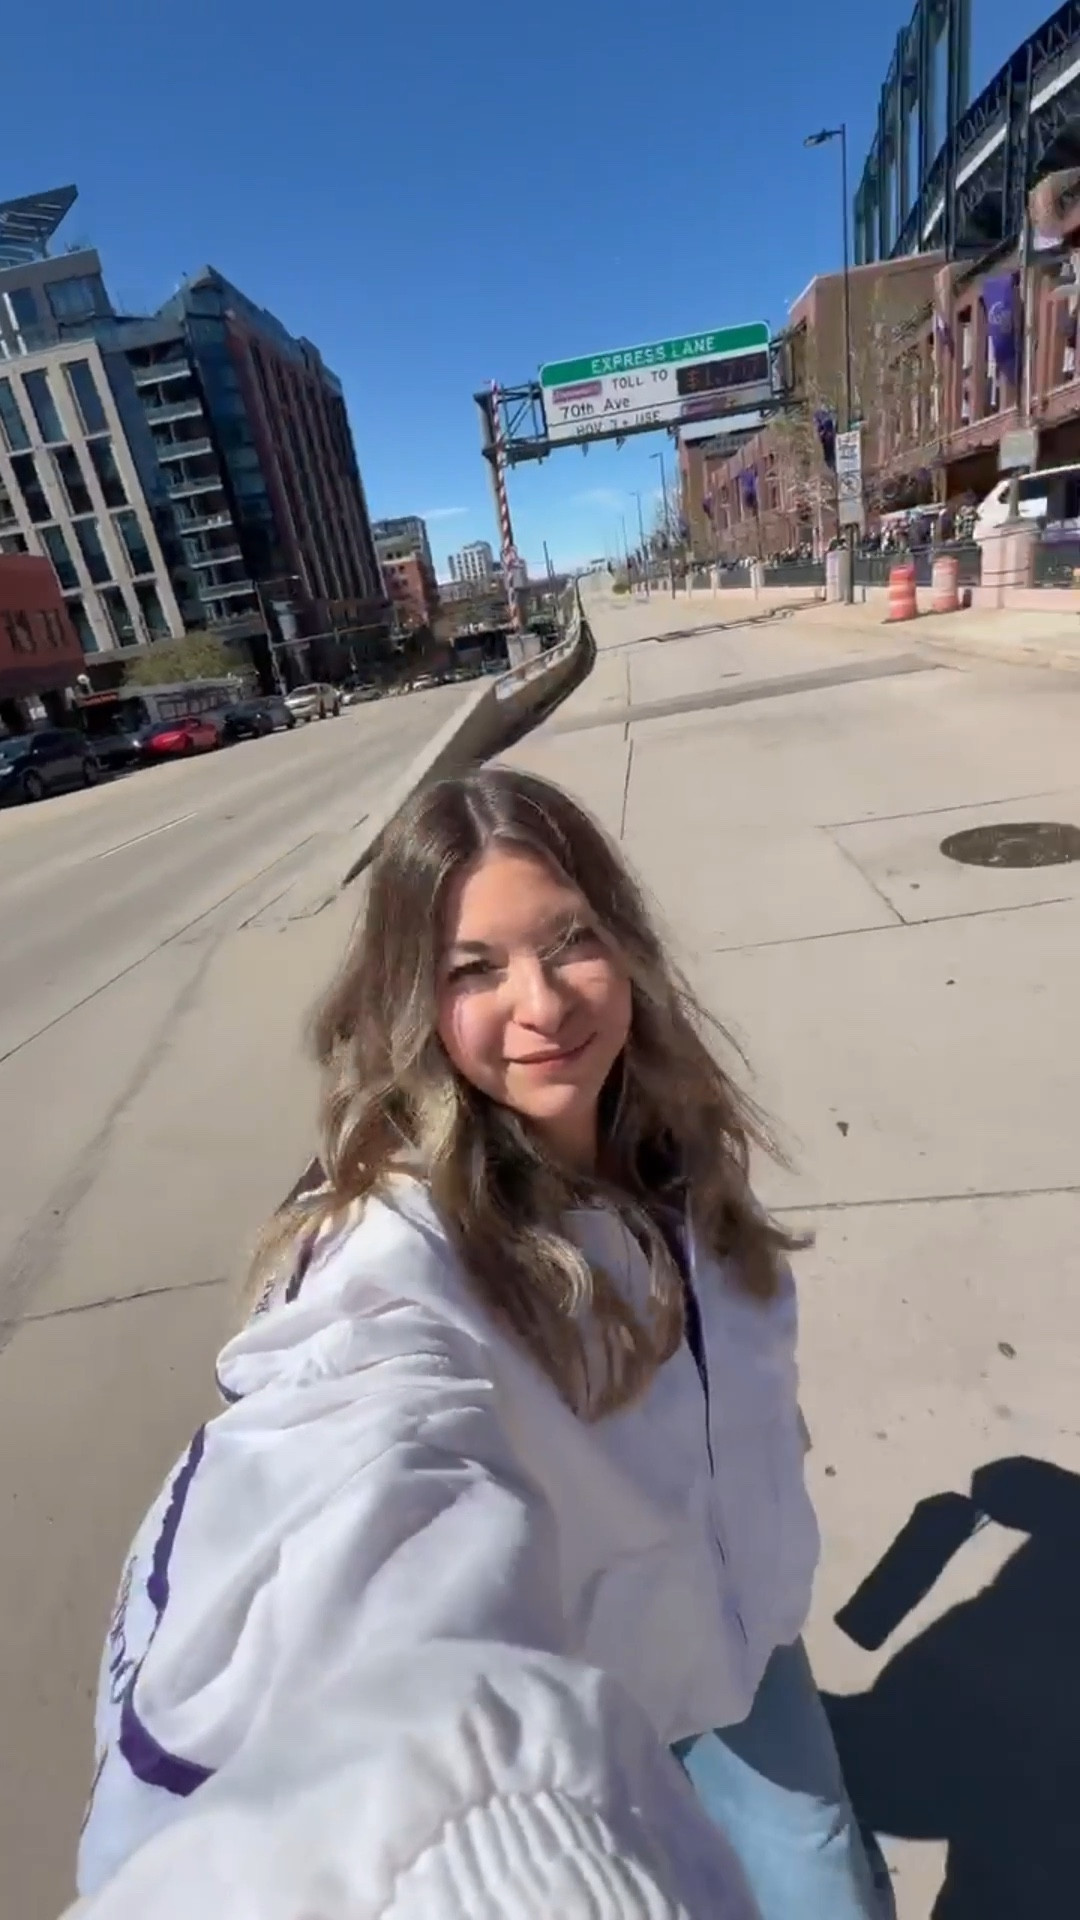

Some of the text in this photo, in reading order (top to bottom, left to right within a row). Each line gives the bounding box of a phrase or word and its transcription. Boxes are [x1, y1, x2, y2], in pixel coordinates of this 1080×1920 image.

[591, 337, 714, 374] EXPRESS LANE
[612, 369, 668, 390] TOLL TO
[560, 397, 630, 419] 70th Ave
[635, 410, 661, 425] USE
